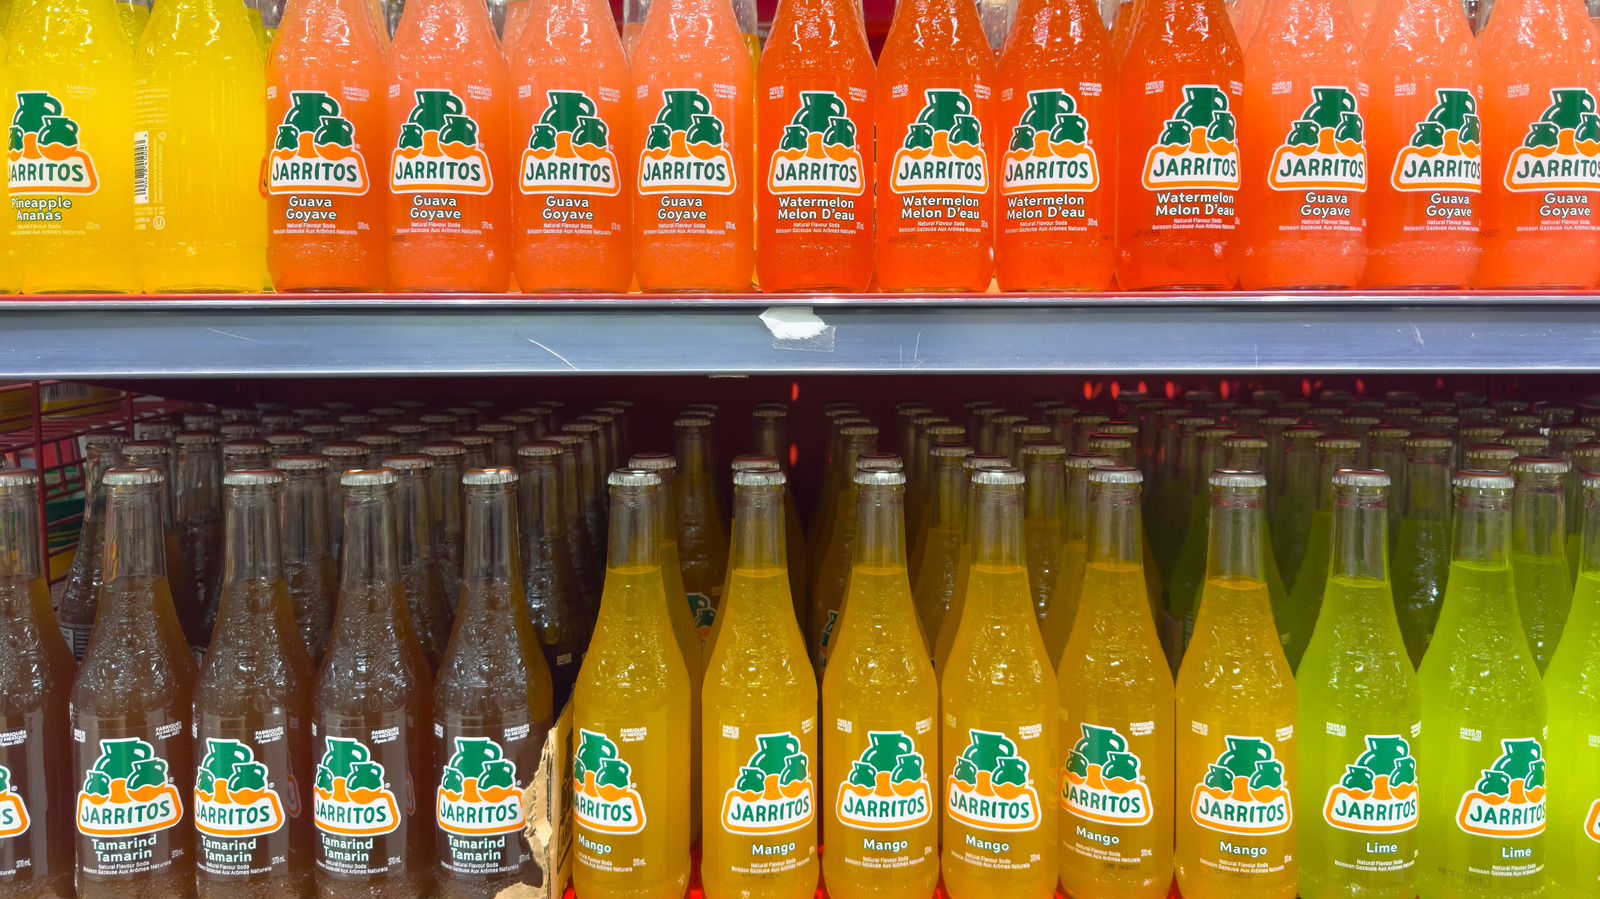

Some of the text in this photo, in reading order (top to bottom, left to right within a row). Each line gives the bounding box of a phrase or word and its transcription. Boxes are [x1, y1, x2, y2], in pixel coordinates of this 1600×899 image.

[273, 163, 357, 181] JARRITOS
[396, 162, 480, 181] JARRITOS
[526, 163, 610, 182] JARRITOS
[644, 162, 725, 181] JARRITOS
[776, 163, 856, 182] JARRITOS
[900, 162, 981, 180] JARRITOS
[1006, 161, 1088, 182] JARRITOS
[1154, 158, 1236, 177] JARRITOS
[1280, 158, 1363, 178] JARRITOS
[12, 197, 72, 210] Pineapple
[289, 196, 332, 207] Guava
[413, 195, 457, 207] Guava
[546, 196, 589, 208] Guava
[661, 196, 702, 207] Guava
[778, 196, 854, 208] Watermelon
[902, 195, 978, 207] Watermelon
[1008, 194, 1084, 207] Watermelon
[1157, 192, 1233, 204] Watermelon
[1305, 192, 1347, 204] Guava
[1431, 193, 1469, 204] Guava
[1544, 193, 1588, 204] Guava
[17, 210, 62, 221] Ananas
[286, 208, 337, 221] Goyave
[410, 208, 461, 221] Goyave
[543, 209, 593, 221] Goyave
[658, 208, 706, 222] Goyave
[778, 208, 816, 220] Melon
[902, 208, 941, 219] Melon
[1007, 208, 1042, 220] Melon
[1155, 205, 1200, 216] Melon
[1300, 205, 1350, 218] Goyave
[1426, 206, 1472, 219] Goyave
[1539, 205, 1590, 219] Goyave
[950, 791, 1029, 819] JARRITOS
[1062, 783, 1140, 814] JARRITOS
[82, 800, 170, 824] JARRITOS
[440, 803, 517, 823] JARRITOS
[574, 793, 632, 821] ARRITOS
[731, 796, 809, 822] JARRITOS
[844, 796, 924, 818] JARRITOS
[1200, 798, 1284, 822] JARRITOS
[1335, 799, 1415, 821] JARRITOS
[196, 806, 270, 824] JARRITOS
[316, 806, 386, 824] JARRITOS
[92, 834, 156, 850] Tamarind
[321, 833, 373, 849] Tamarind
[448, 835, 505, 849] Tamarind
[1076, 825, 1119, 845] Mango
[201, 836, 256, 850] Tamarind
[578, 833, 611, 854] Mango
[752, 842, 795, 855] Mango
[863, 838, 908, 853] Mango
[965, 834, 1009, 853] Mango
[1220, 840, 1267, 858] Mango
[1366, 842, 1397, 854] Lime
[95, 849, 152, 862] Tamarin
[204, 849, 252, 862] Tamarin
[324, 846, 369, 862] Tamarin
[451, 848, 501, 861] Tamarin
[1502, 847, 1531, 858] Lime
